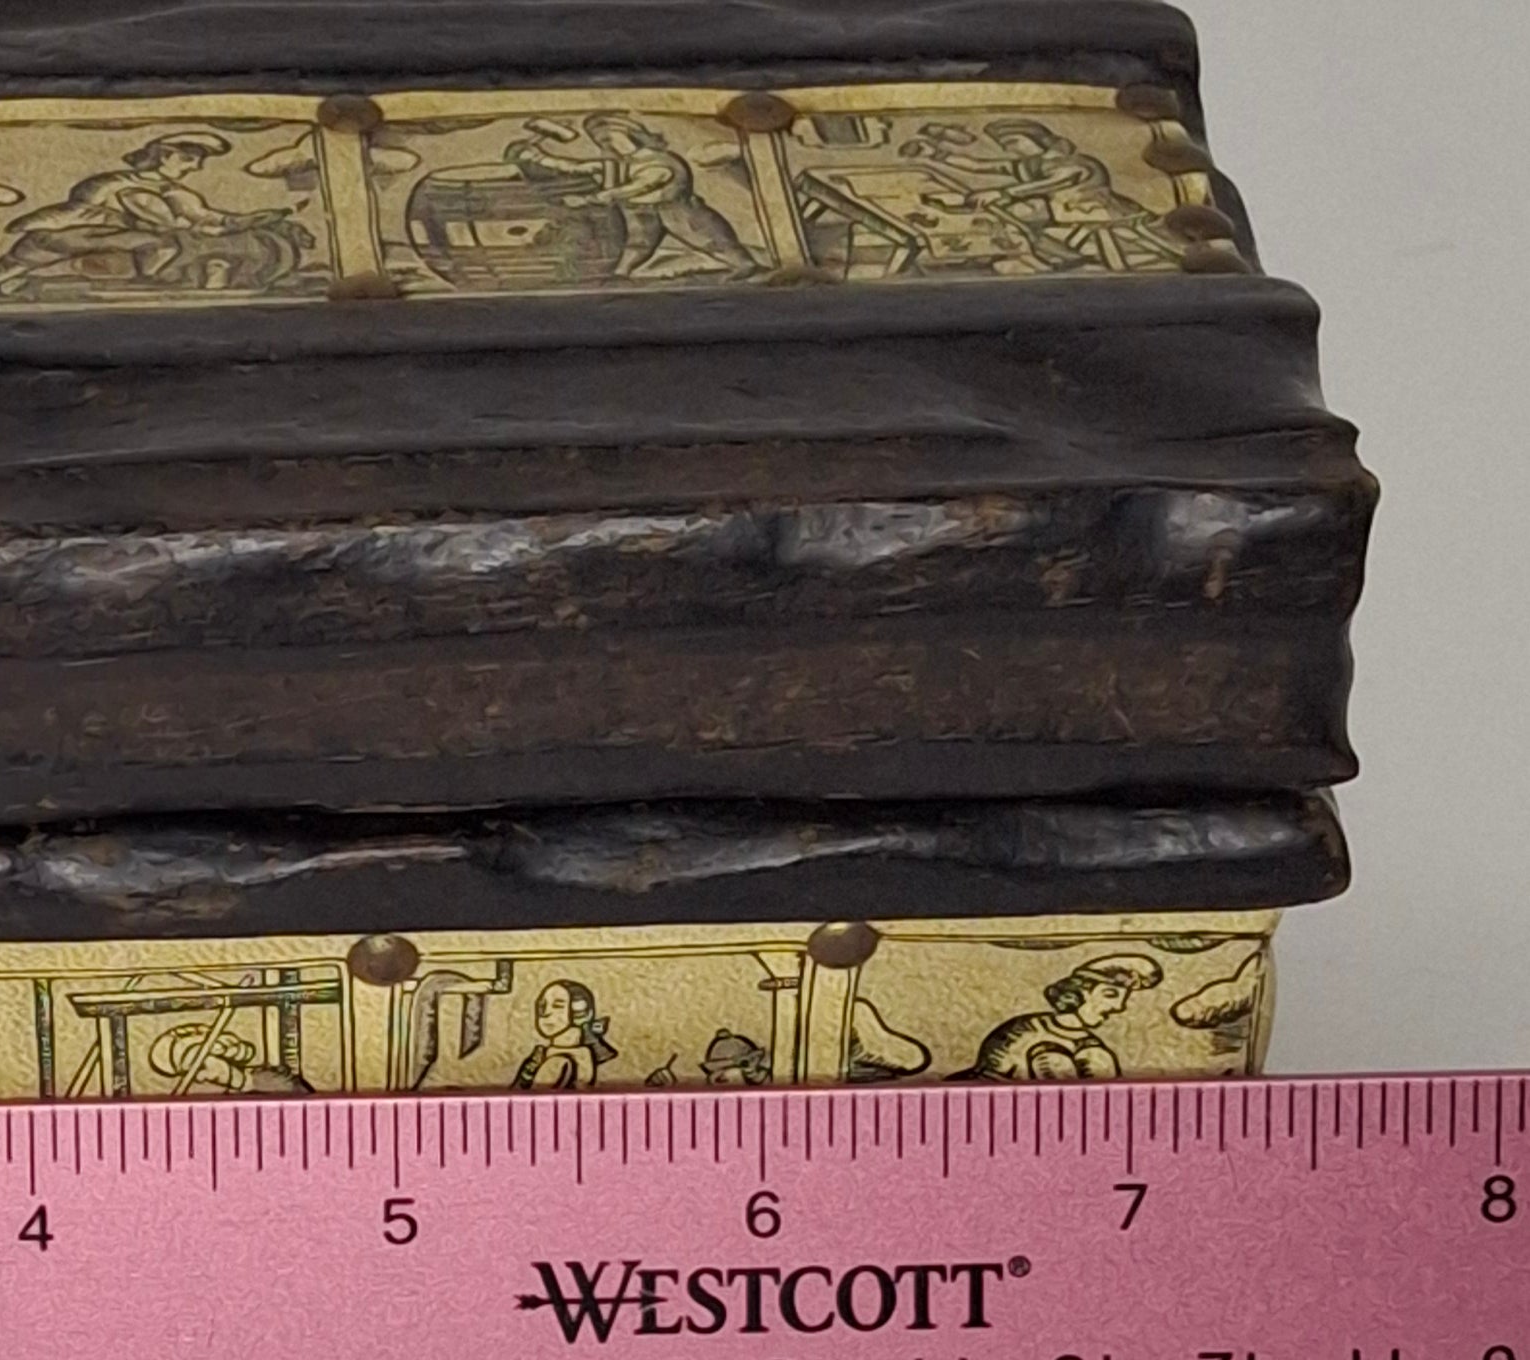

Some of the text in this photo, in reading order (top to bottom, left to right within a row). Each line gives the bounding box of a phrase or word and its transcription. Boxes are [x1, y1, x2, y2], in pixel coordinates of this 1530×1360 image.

[17, 1204, 55, 1252] 4
[383, 1197, 418, 1246] 5
[745, 1190, 782, 1239] 6
[1113, 1183, 1148, 1231] 7
[1480, 1174, 1517, 1223] 8
